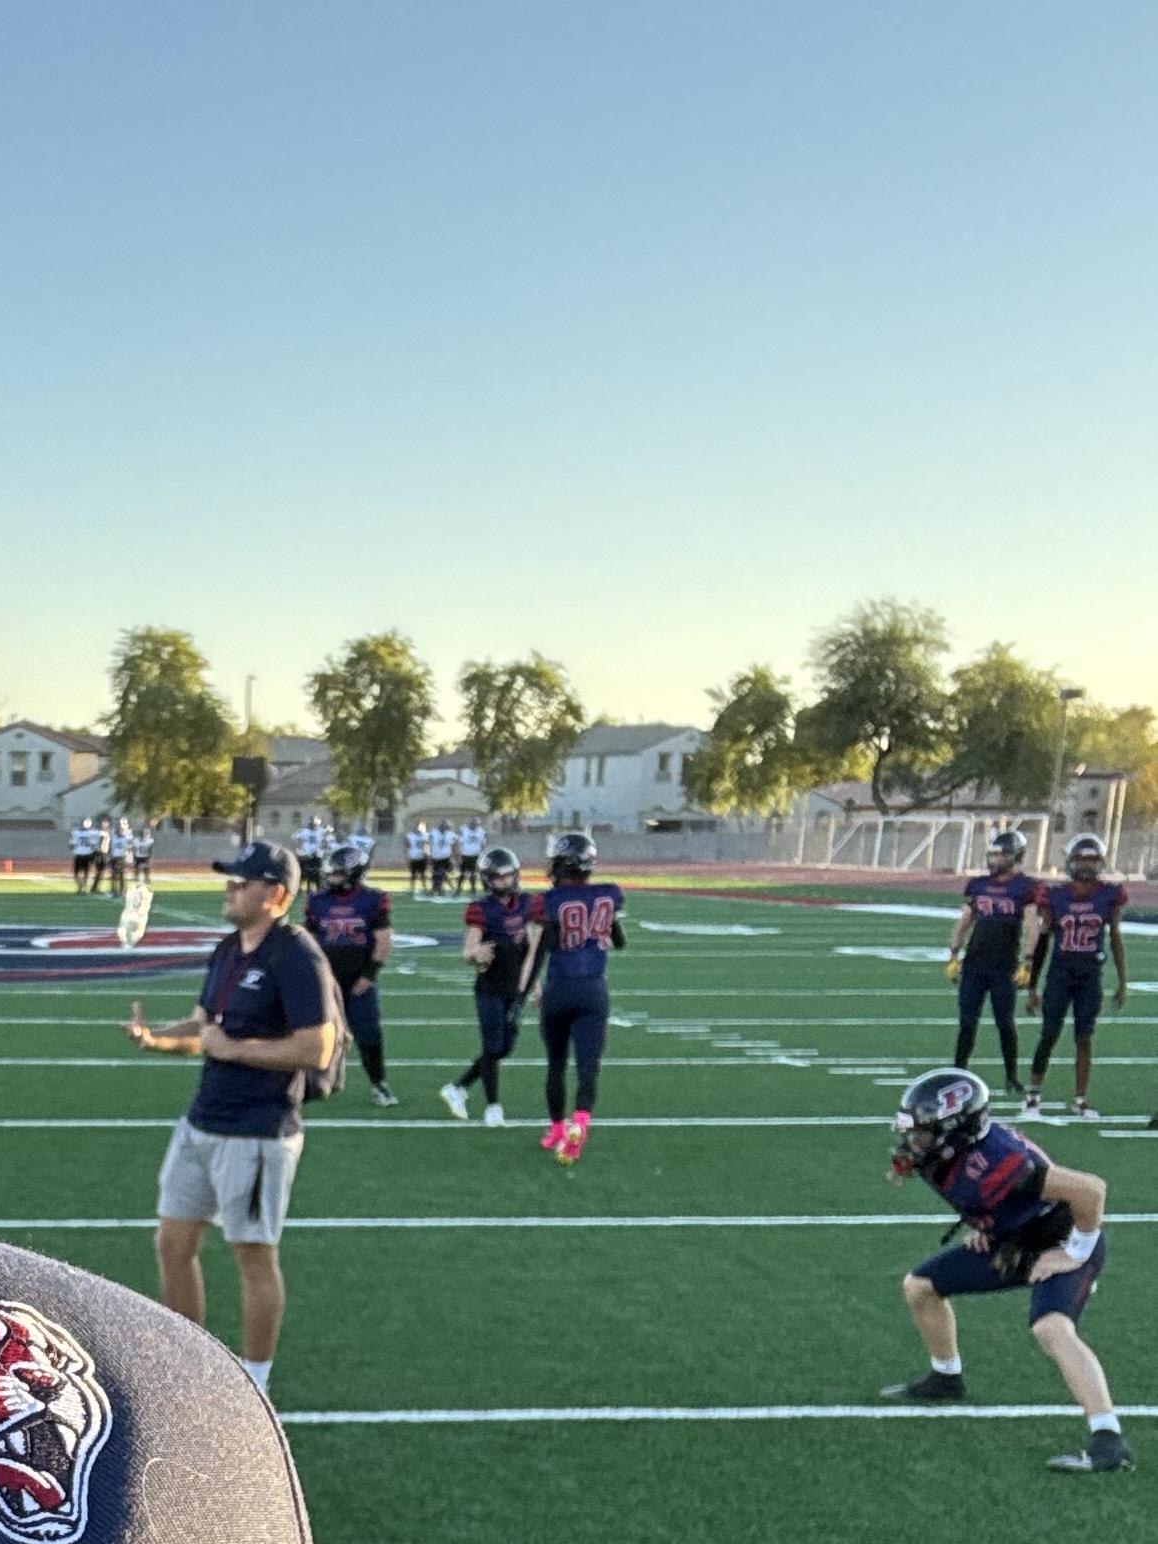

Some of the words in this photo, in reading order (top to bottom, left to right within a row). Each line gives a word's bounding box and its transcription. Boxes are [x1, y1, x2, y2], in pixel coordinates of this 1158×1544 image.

[558, 896, 614, 950] 84
[1059, 913, 1103, 952] 12
[937, 1080, 973, 1119] P
